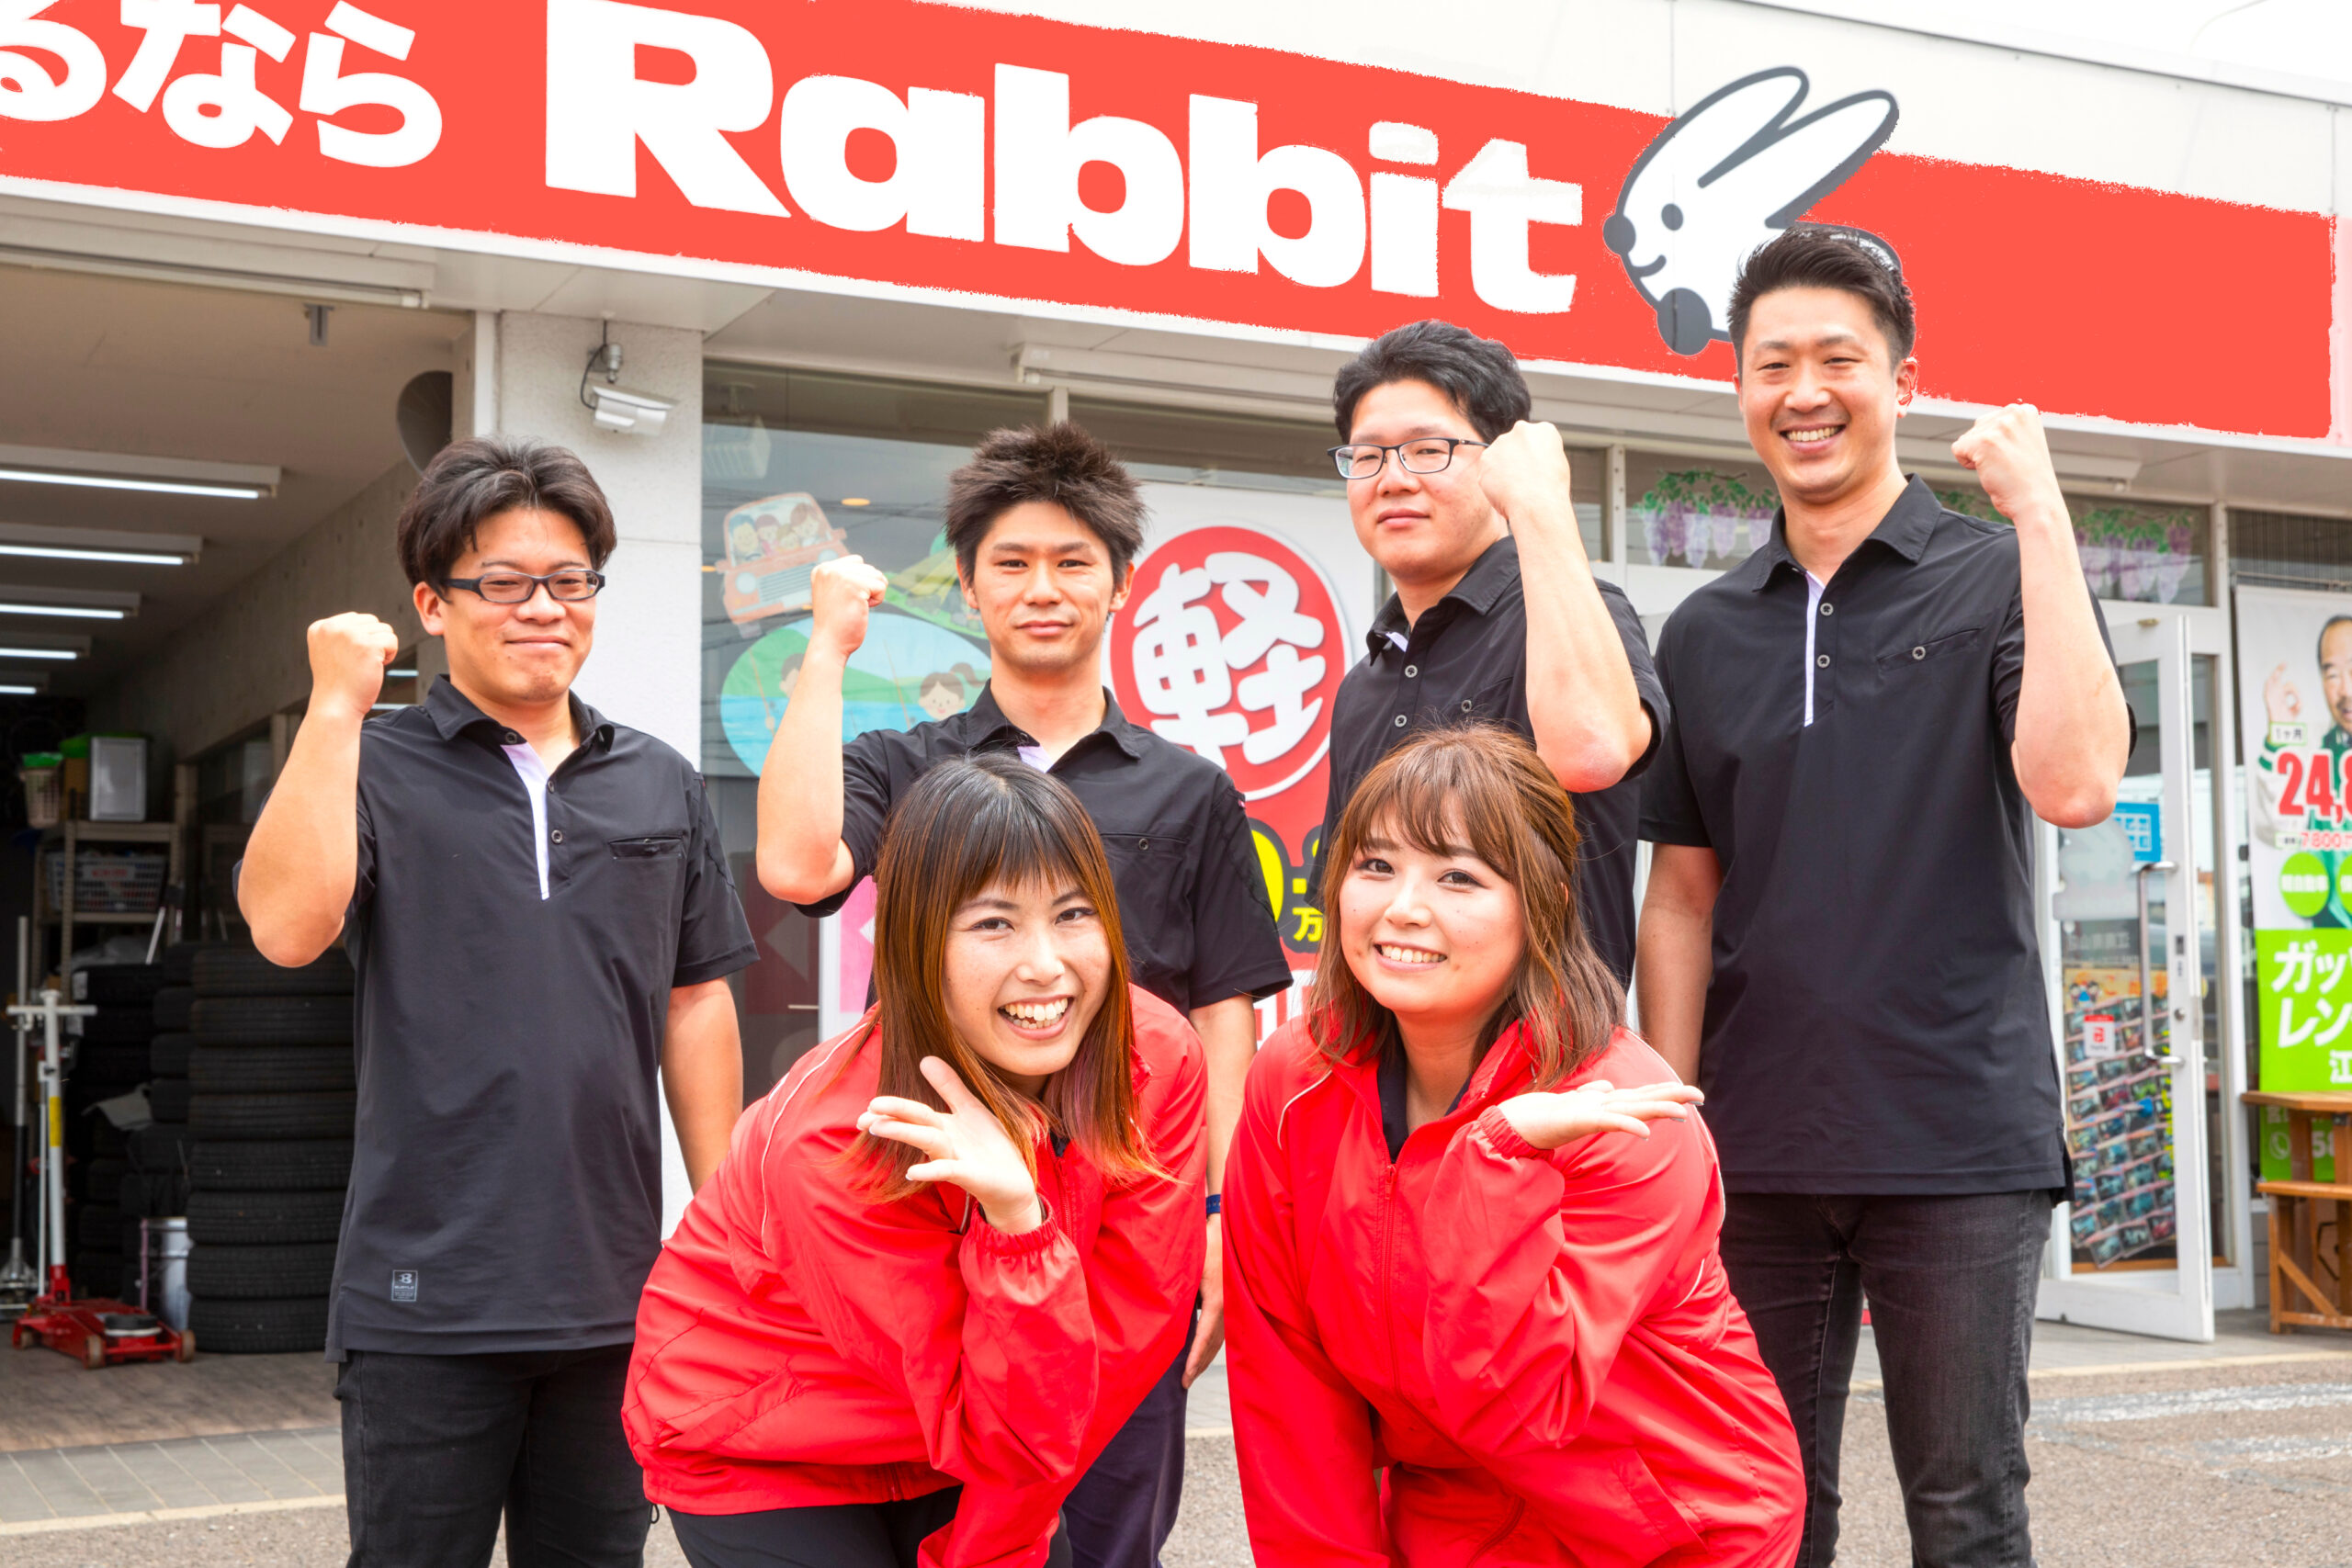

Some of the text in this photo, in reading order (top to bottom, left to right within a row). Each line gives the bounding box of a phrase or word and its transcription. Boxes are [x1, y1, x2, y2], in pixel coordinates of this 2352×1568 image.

[546, 0, 1582, 314] Rabbit
[1133, 551, 1326, 770] 軽
[2272, 941, 2352, 993] ガッ
